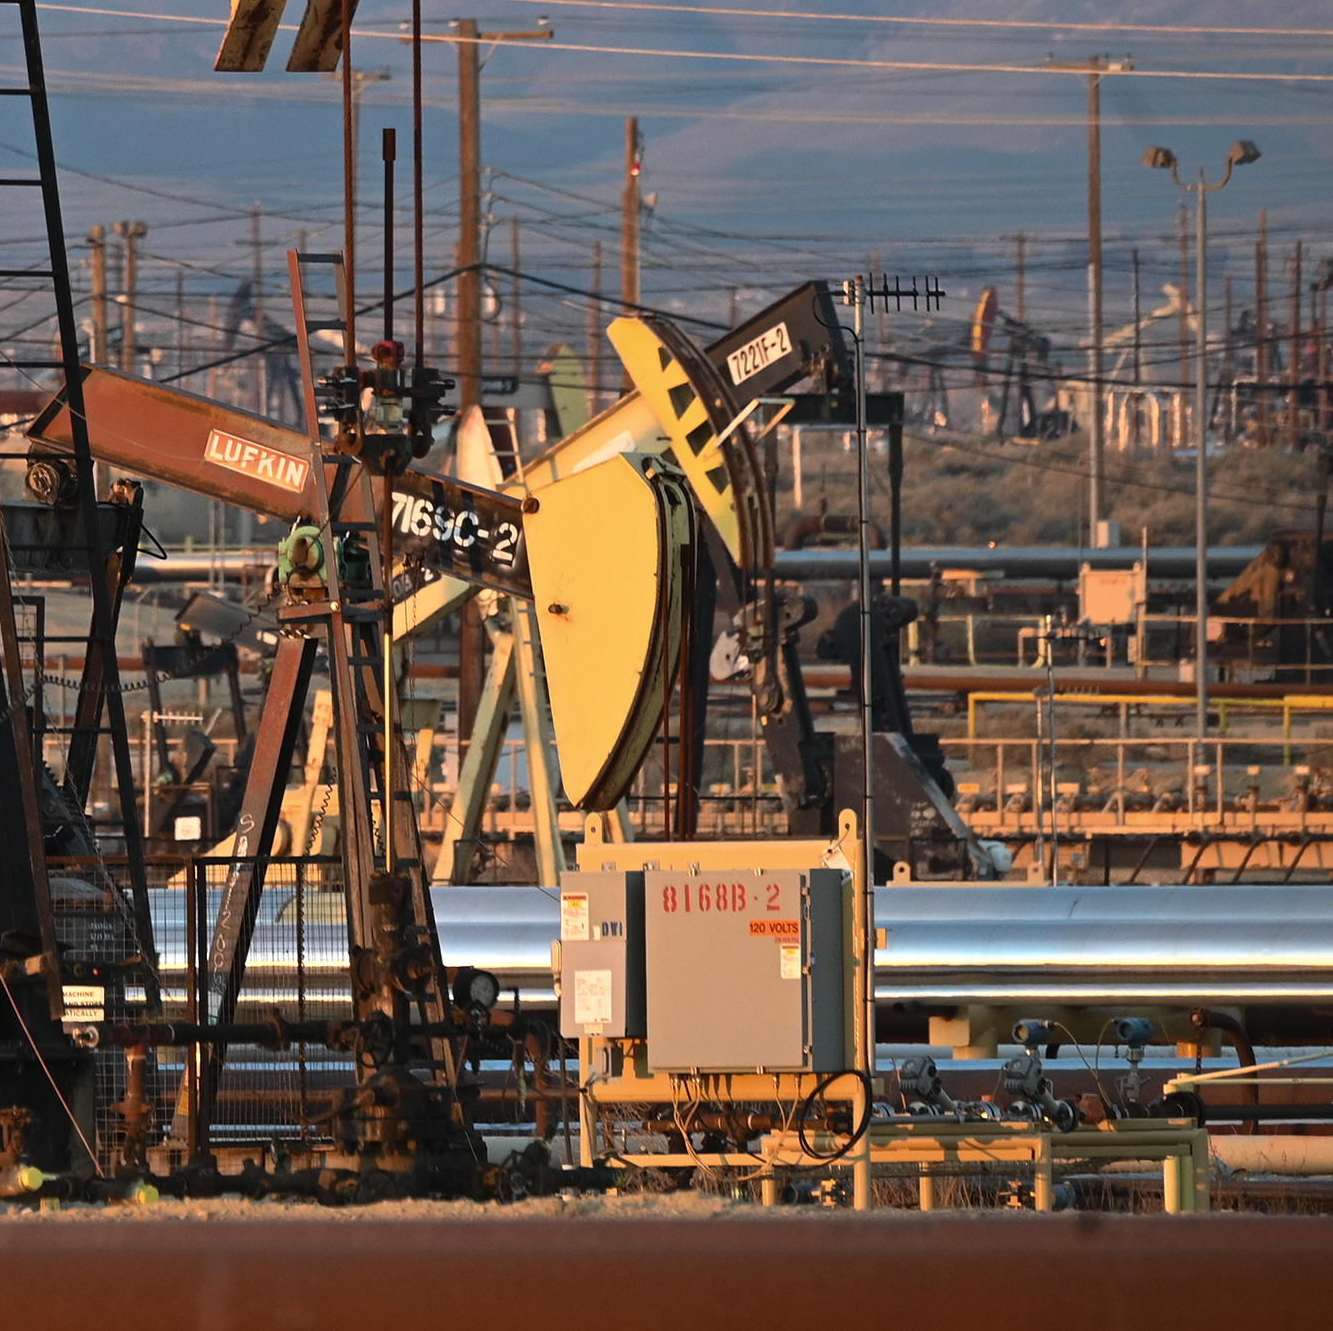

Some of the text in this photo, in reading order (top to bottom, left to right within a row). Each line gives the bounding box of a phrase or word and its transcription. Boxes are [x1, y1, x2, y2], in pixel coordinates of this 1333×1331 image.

[732, 328, 788, 380] 7221F-2
[209, 435, 304, 487] LUFKIN
[392, 492, 518, 562] 7169C-2
[750, 923, 799, 933] 120 VOLTS
